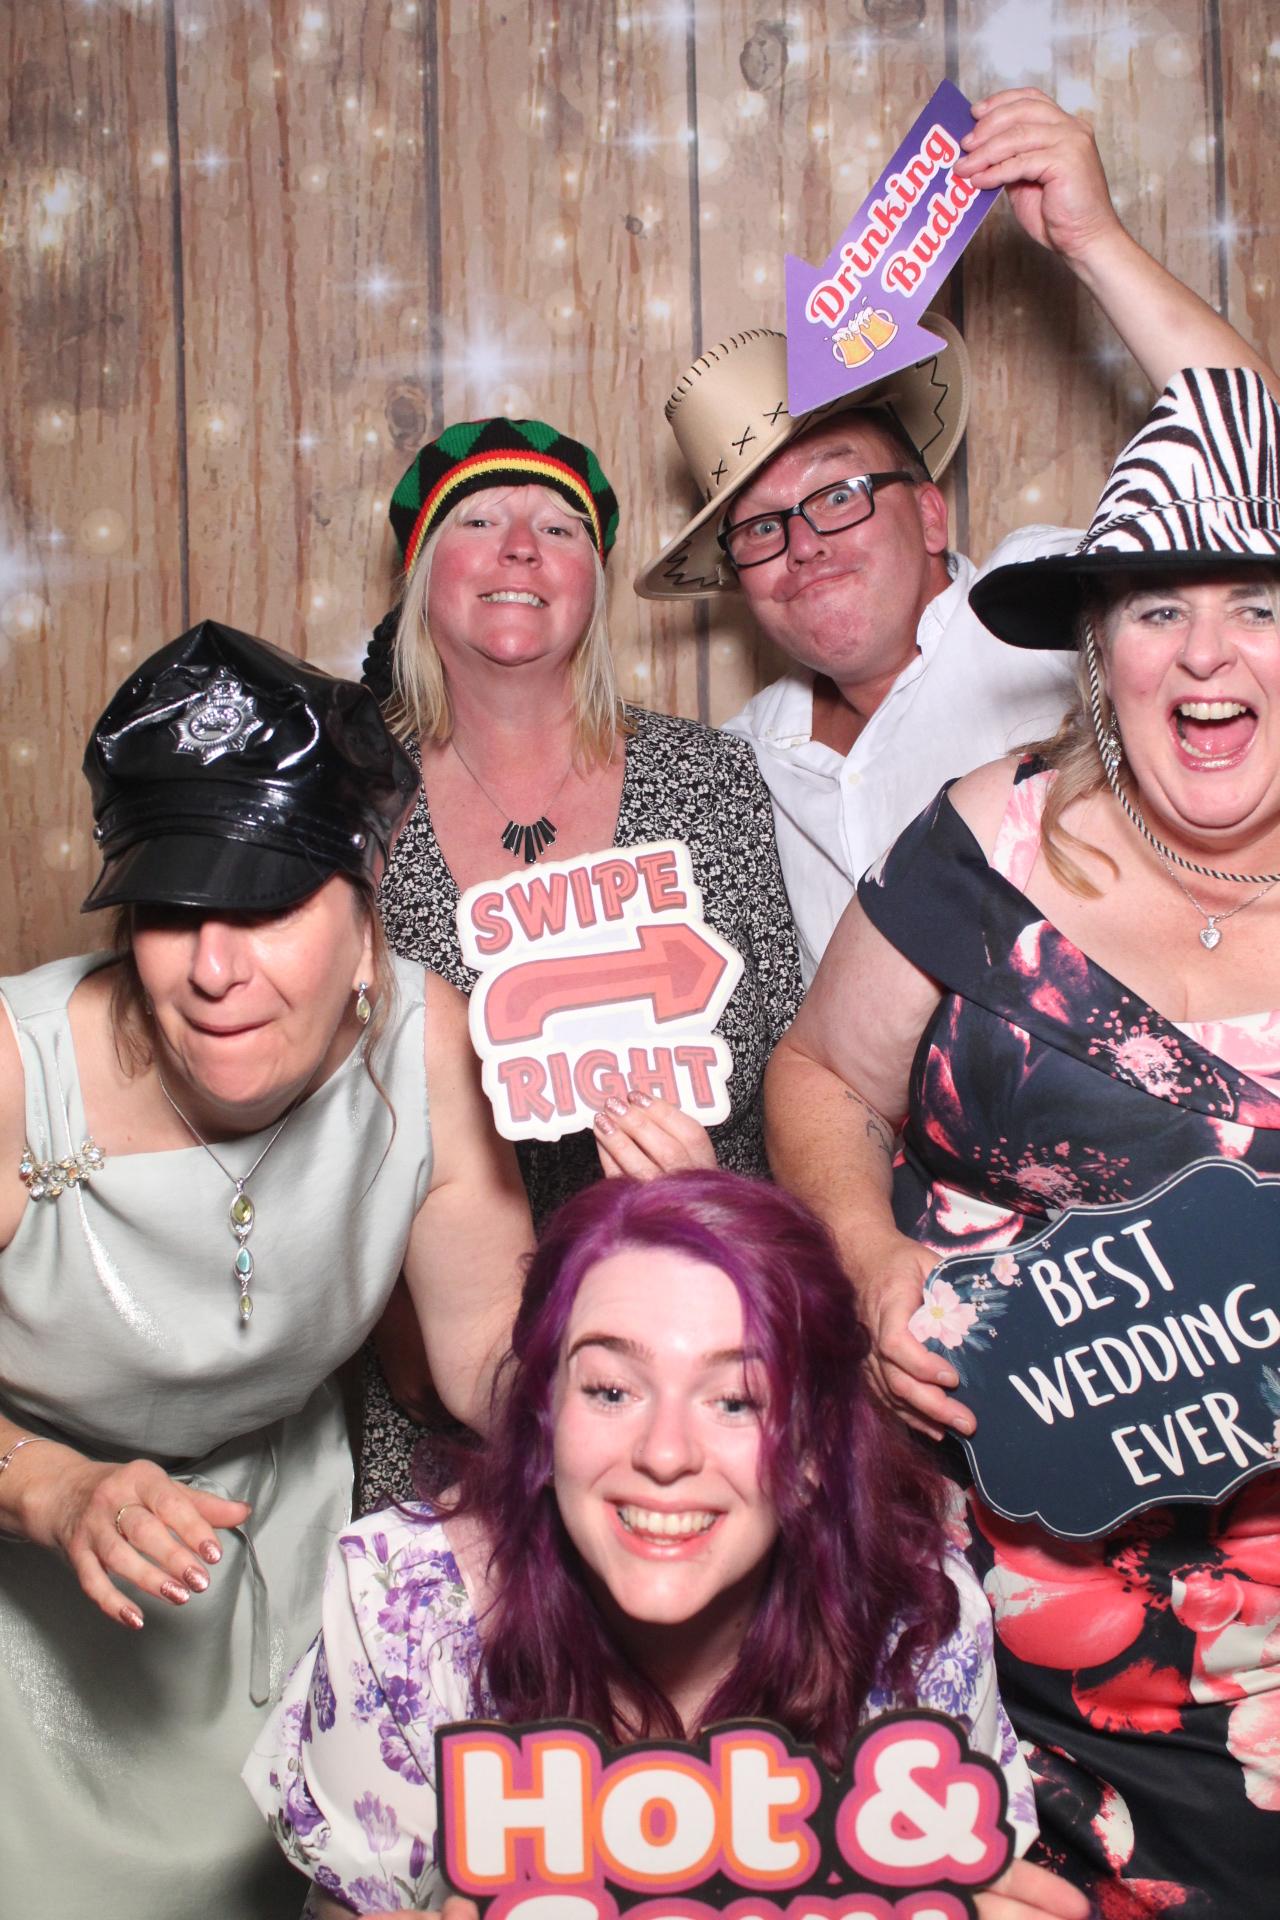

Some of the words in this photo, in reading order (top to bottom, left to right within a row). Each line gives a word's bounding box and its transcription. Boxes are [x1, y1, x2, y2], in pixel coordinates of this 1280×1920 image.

[809, 128, 957, 323] Drinking
[885, 172, 978, 293] Budd
[470, 850, 687, 955] SWIPE
[497, 1044, 718, 1123] RIGHT
[1029, 1218, 1175, 1328] BEST
[1008, 1283, 1280, 1425] WEDDING
[1110, 1391, 1270, 1487] EVER
[460, 1745, 803, 1878] Hot
[854, 1738, 989, 1868] &
